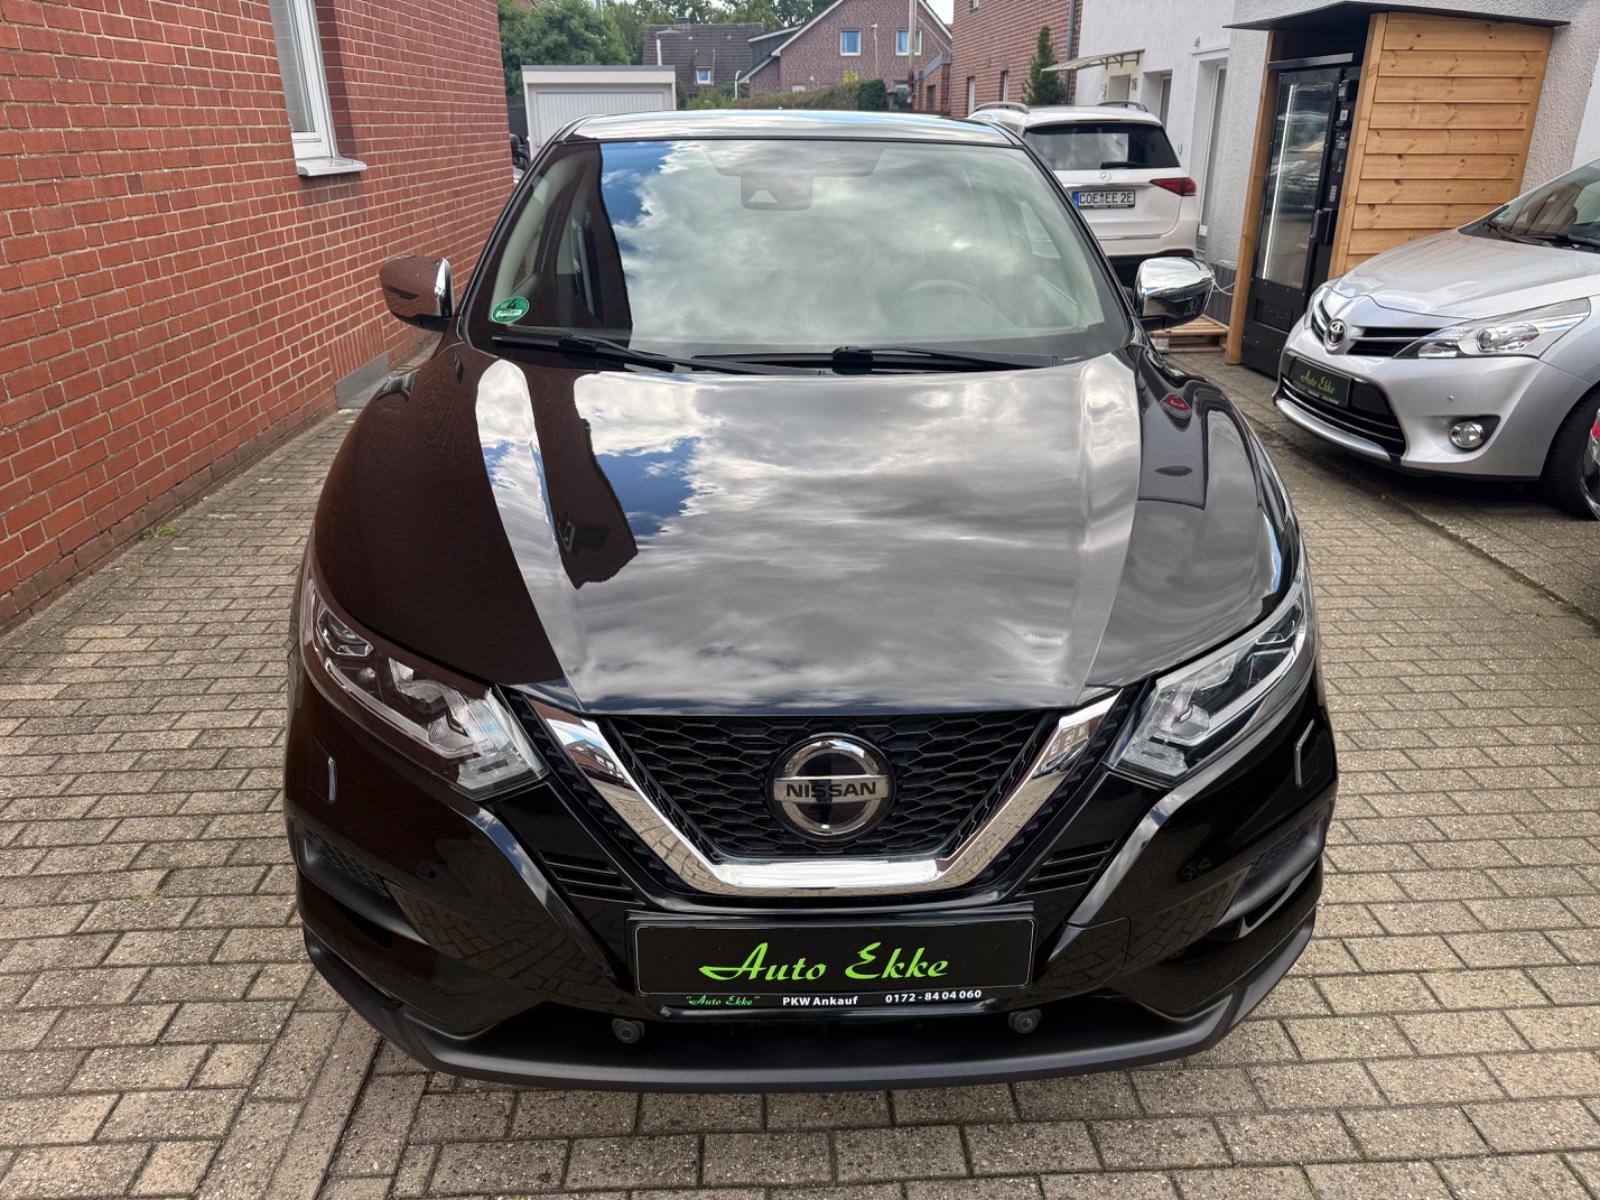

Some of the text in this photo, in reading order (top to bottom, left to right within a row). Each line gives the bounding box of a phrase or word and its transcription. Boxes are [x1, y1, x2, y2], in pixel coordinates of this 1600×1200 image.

[786, 781, 876, 798] NISSAN
[698, 941, 949, 981] Auto Ekke
[782, 995, 859, 1006] PKW Ankauf
